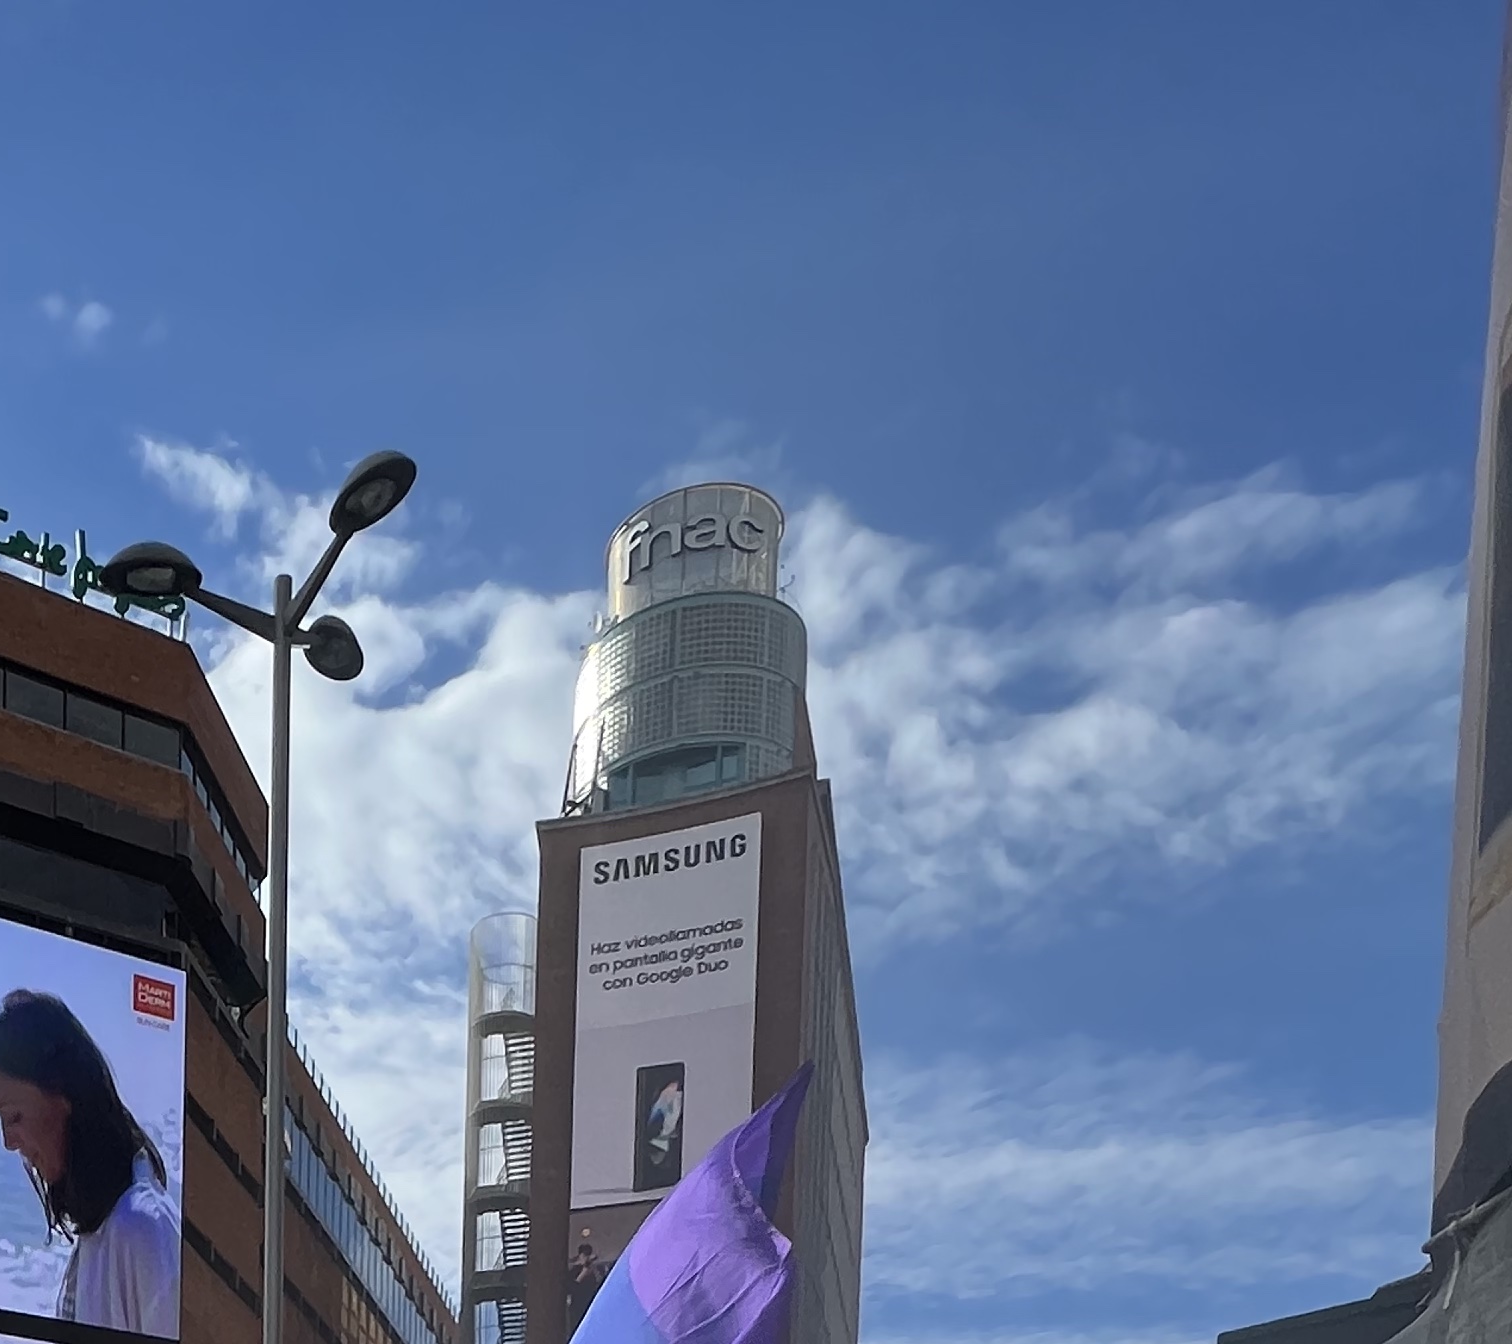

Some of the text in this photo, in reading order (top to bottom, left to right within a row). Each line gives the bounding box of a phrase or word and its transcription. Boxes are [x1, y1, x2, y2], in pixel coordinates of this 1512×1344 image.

[623, 514, 766, 585] fnac
[593, 834, 747, 885] SAMSUNG
[589, 936, 744, 975] en pantalla gigante
[590, 917, 744, 956] Haz videollamadas
[602, 958, 730, 991] con Google Duo
